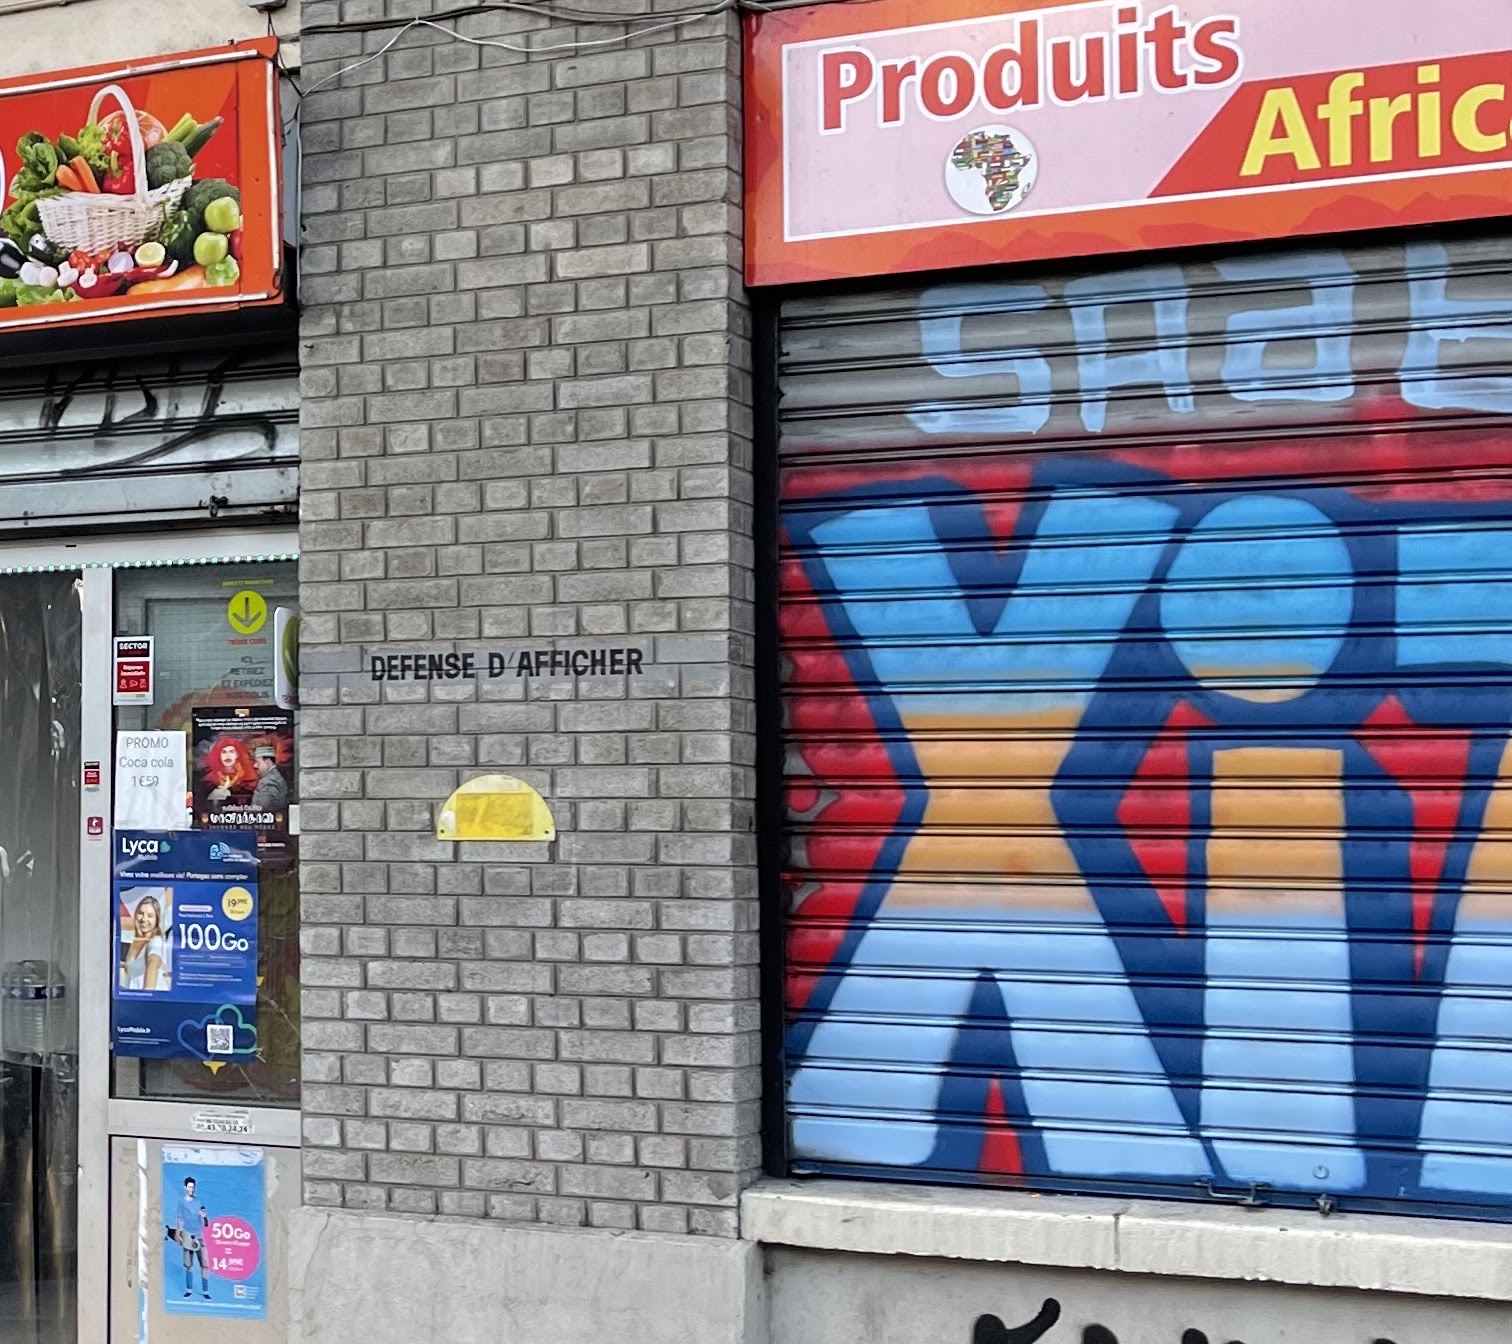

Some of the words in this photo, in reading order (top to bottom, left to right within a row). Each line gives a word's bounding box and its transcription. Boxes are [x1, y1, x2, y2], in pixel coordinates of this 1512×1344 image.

[820, 3, 1243, 134] Produits
[1239, 64, 1512, 177] Afric
[371, 652, 476, 681] DEFENSE
[126, 737, 169, 748] PROMO
[119, 756, 148, 768] Coca
[150, 756, 174, 768] cola
[122, 837, 159, 856] Lyca
[179, 923, 249, 951] 100Go
[211, 1222, 251, 1240] 50Go
